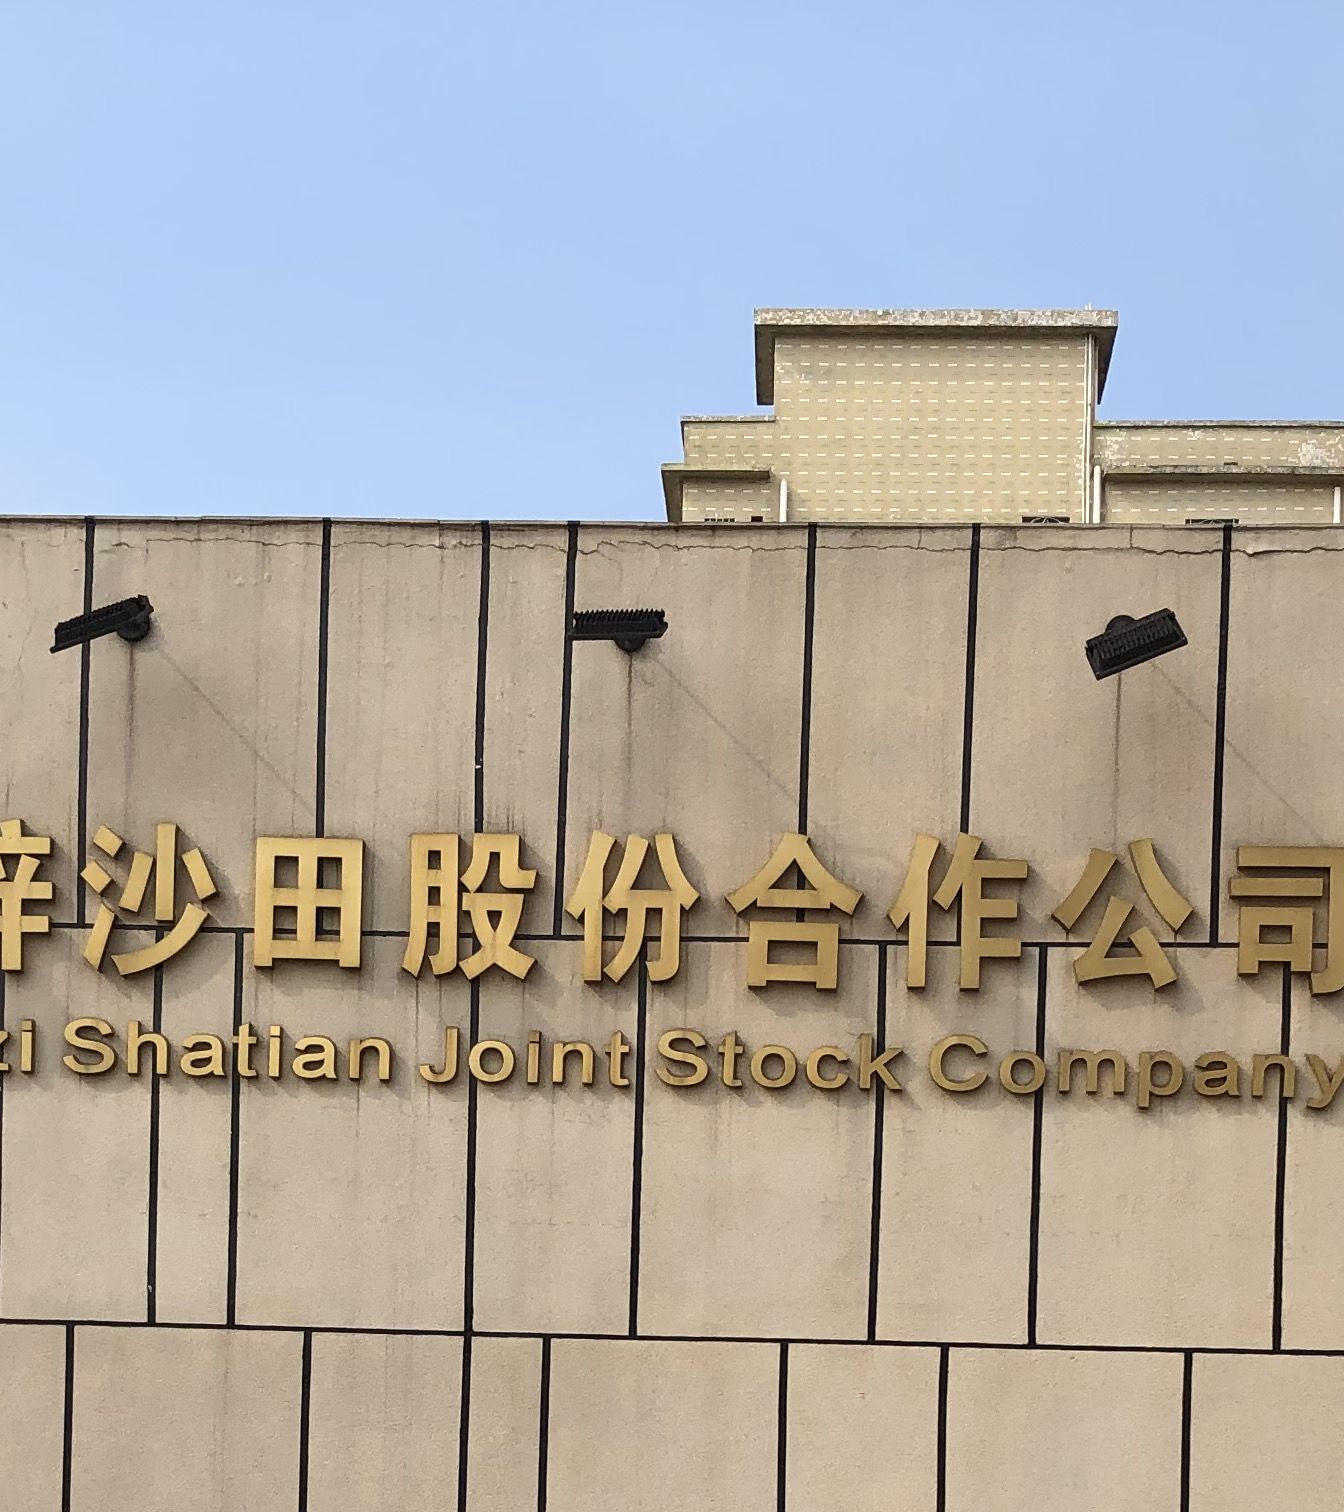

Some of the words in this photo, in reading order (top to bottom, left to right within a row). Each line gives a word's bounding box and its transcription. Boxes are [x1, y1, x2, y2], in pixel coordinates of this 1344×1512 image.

[62, 1016, 393, 1084] Shatian
[419, 1024, 632, 1089] Joint
[655, 1029, 906, 1092] Stock
